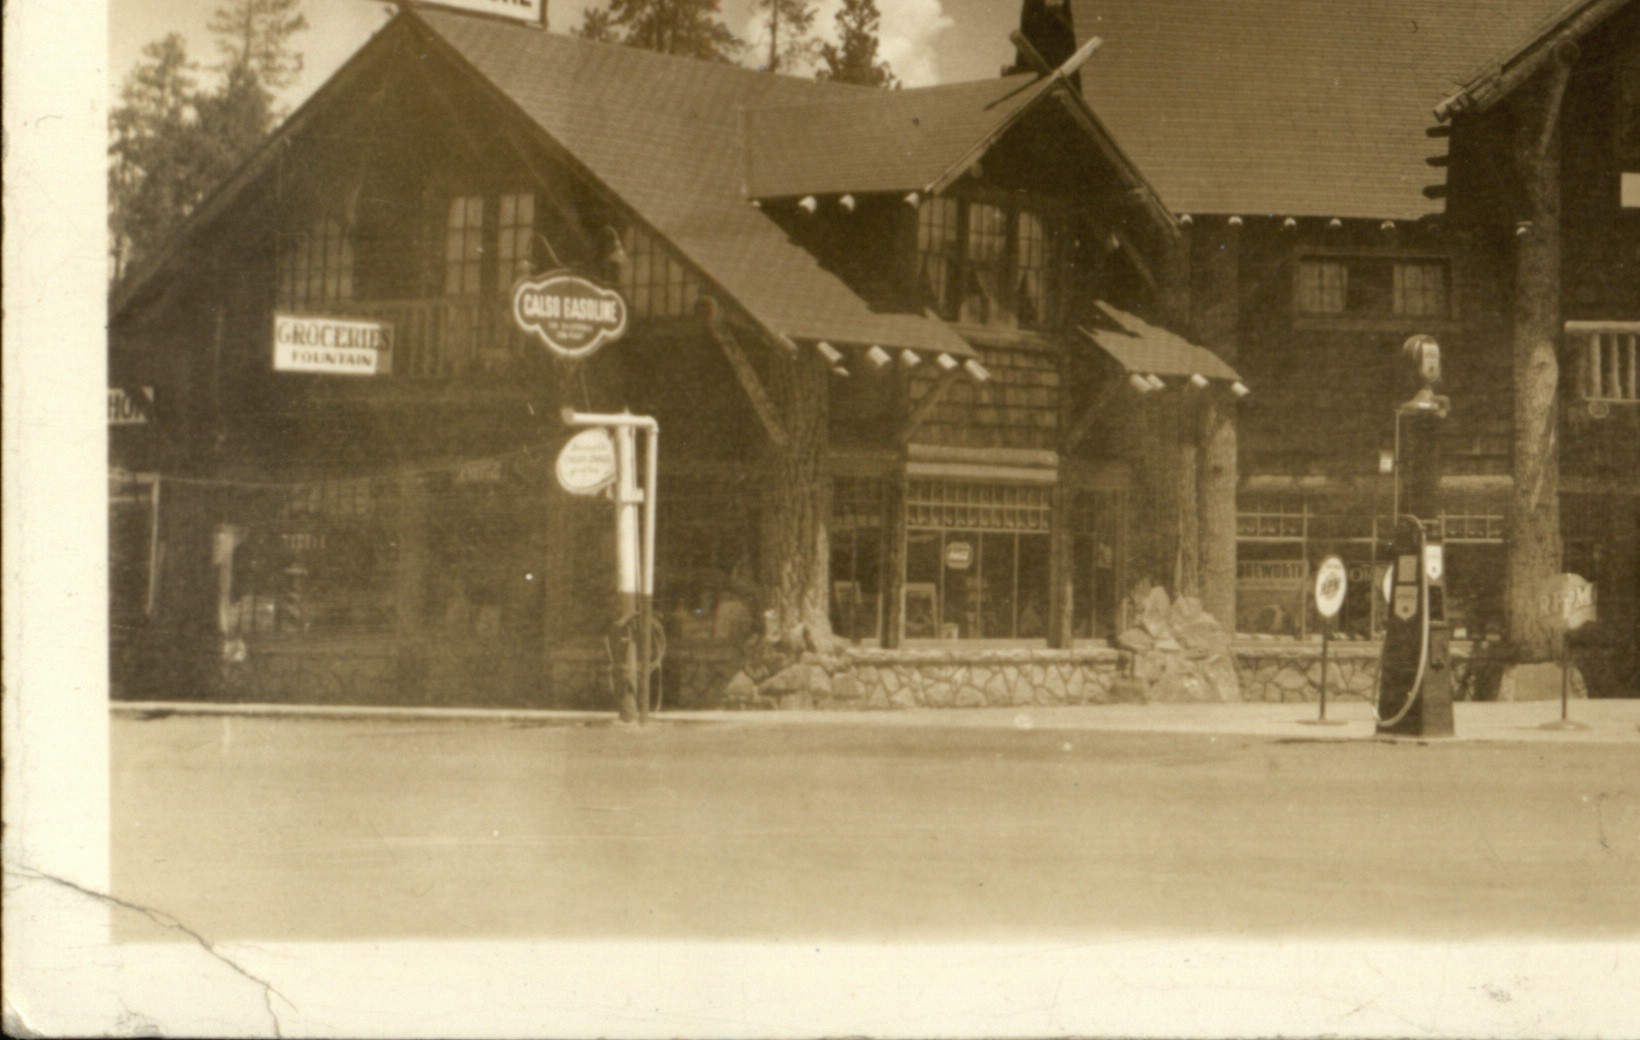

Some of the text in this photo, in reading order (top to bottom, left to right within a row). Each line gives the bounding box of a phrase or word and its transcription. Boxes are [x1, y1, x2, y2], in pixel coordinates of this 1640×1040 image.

[523, 293, 618, 323] CALSO GASOLINE
[278, 321, 392, 351] GROCERIES
[292, 350, 371, 367] FOUNTAIN
